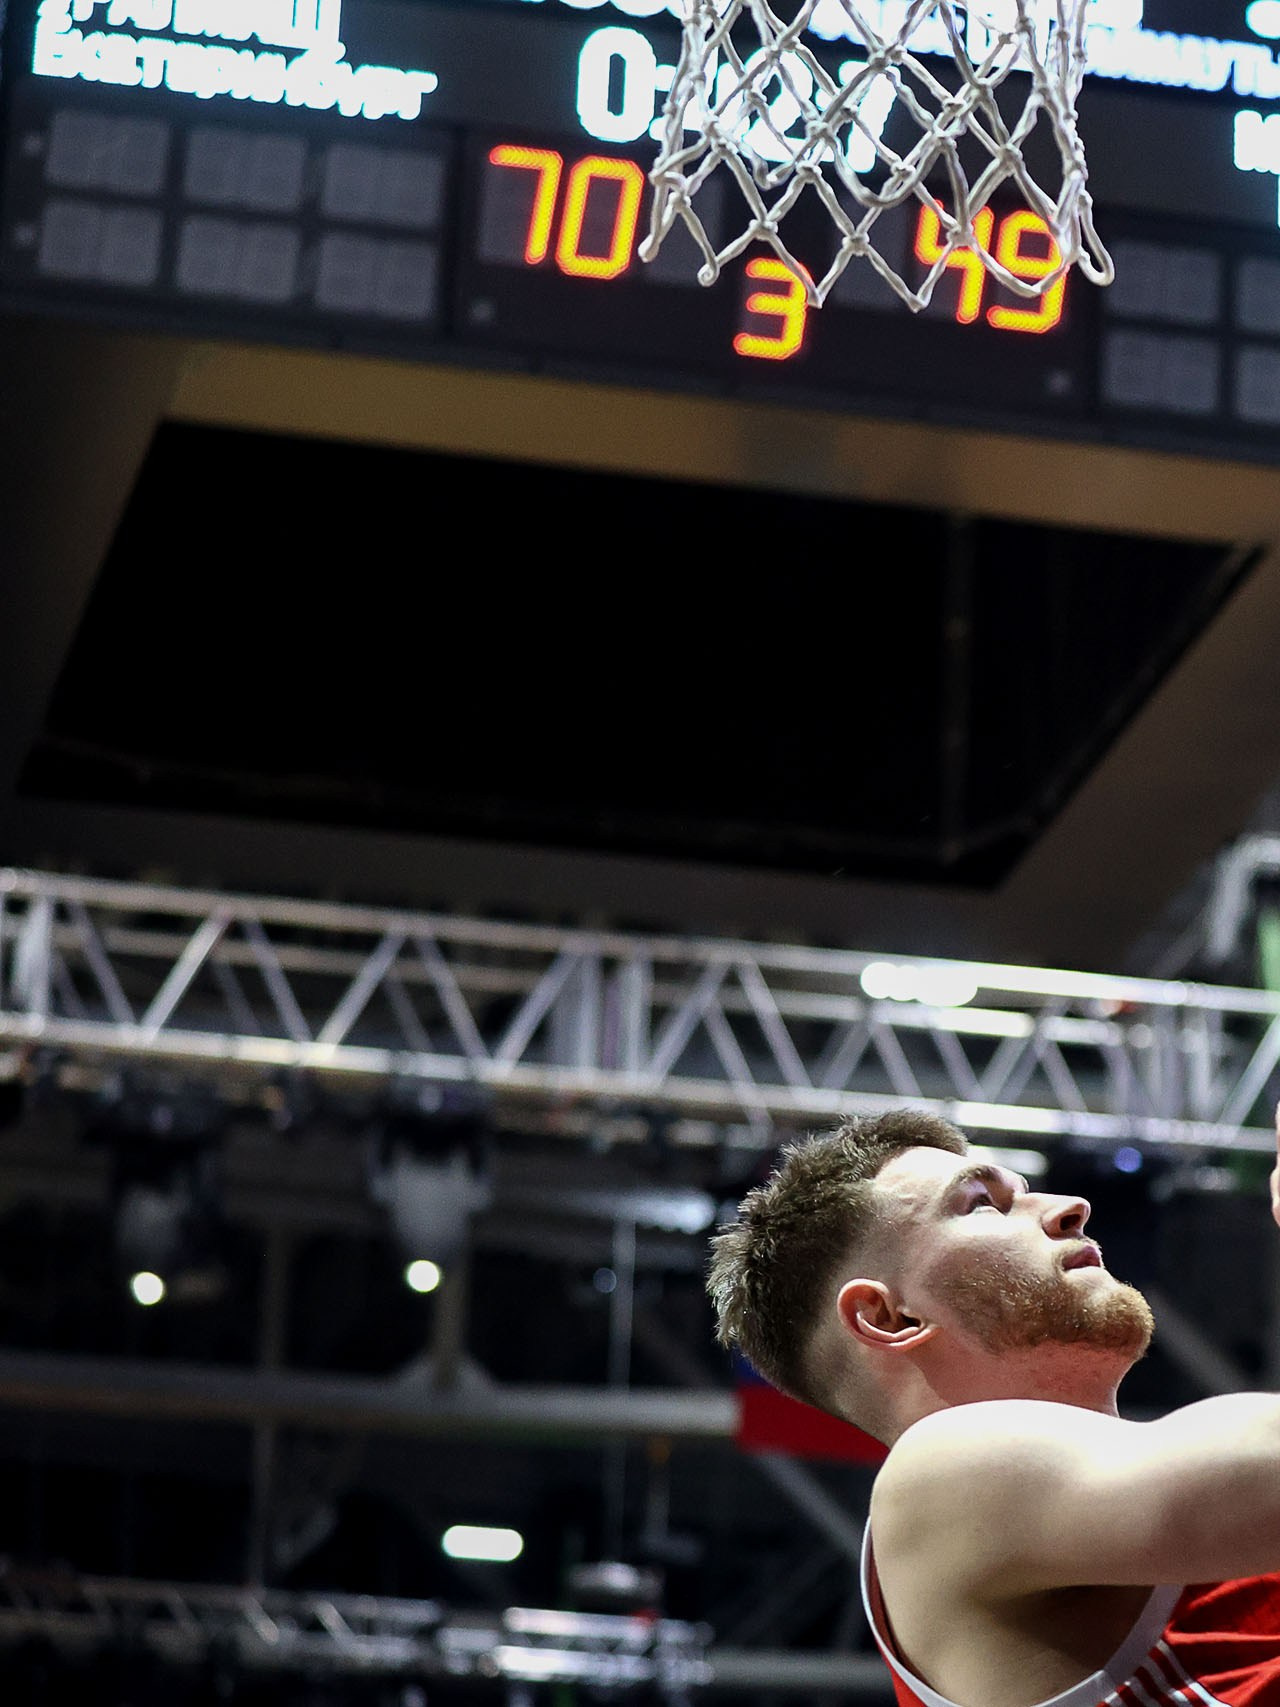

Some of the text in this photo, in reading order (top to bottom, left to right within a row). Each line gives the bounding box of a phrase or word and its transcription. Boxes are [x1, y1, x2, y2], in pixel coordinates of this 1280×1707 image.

[489, 144, 644, 279] 70
[914, 199, 1072, 334] 49
[733, 256, 812, 360] 3
